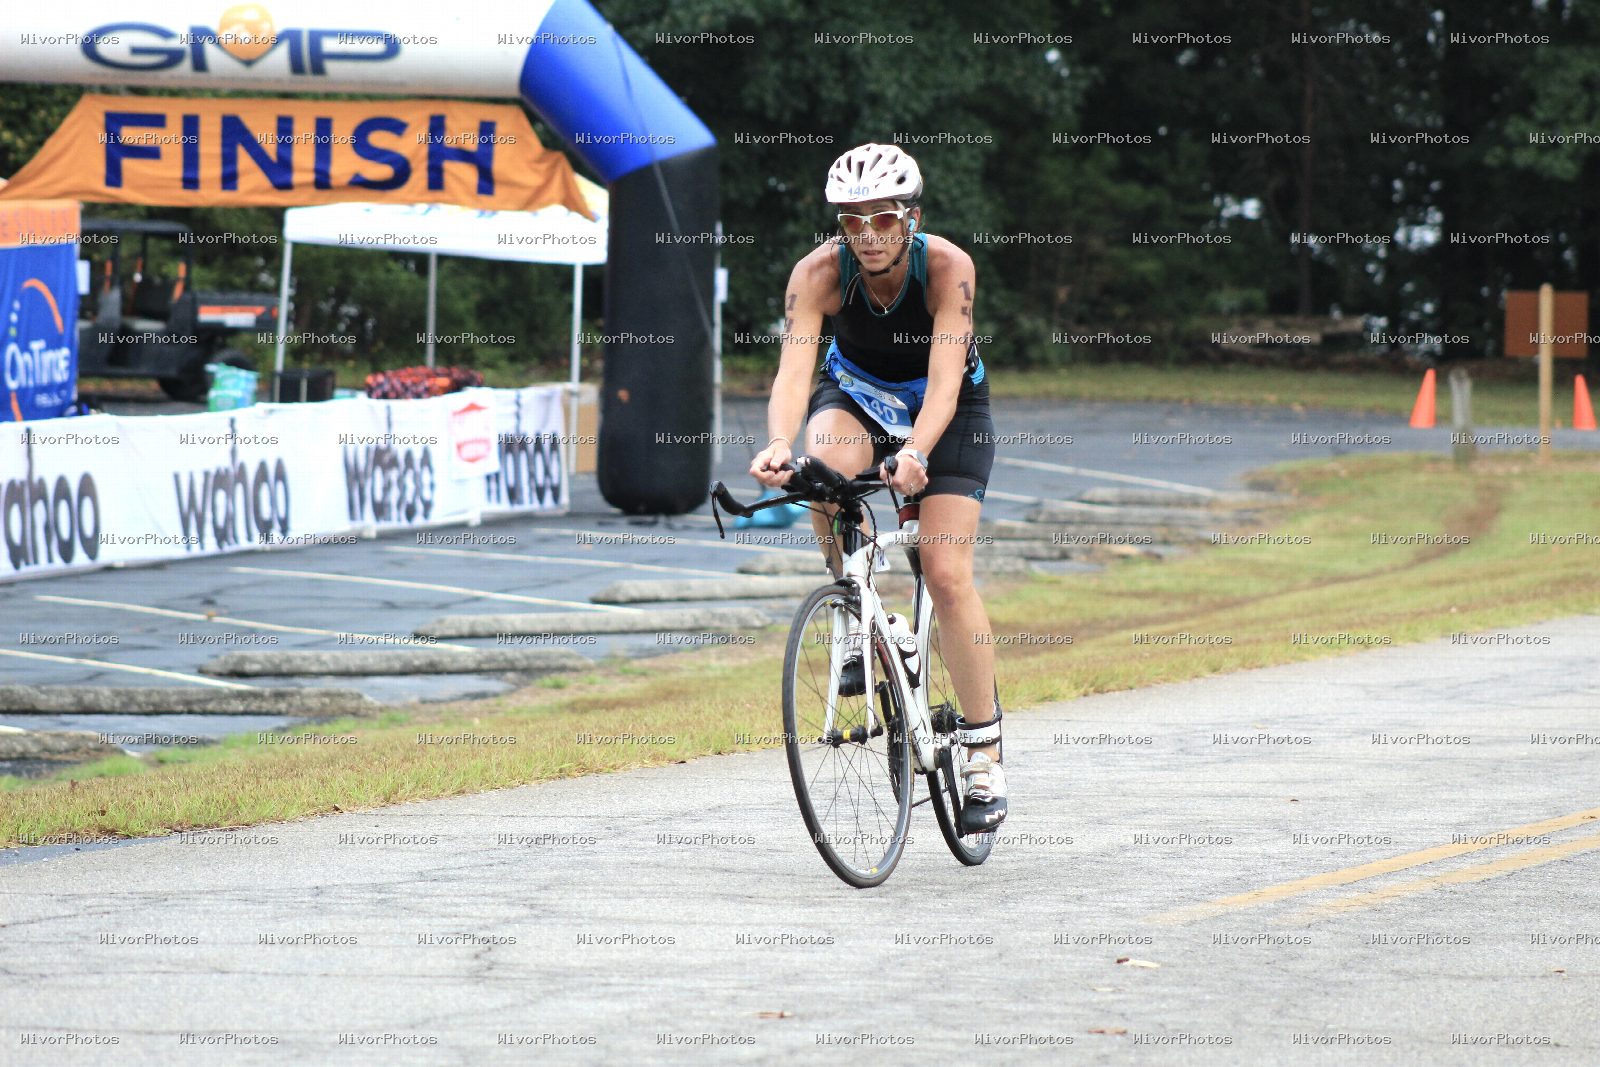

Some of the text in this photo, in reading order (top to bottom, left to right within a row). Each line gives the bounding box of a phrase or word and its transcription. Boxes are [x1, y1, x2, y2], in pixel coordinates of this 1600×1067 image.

[82, 22, 401, 76] GMP
[104, 110, 496, 195] FINISH
[847, 186, 870, 197] 140
[0, 428, 100, 570] ahoo
[173, 417, 290, 550] wahoo
[343, 404, 435, 522] wahoo
